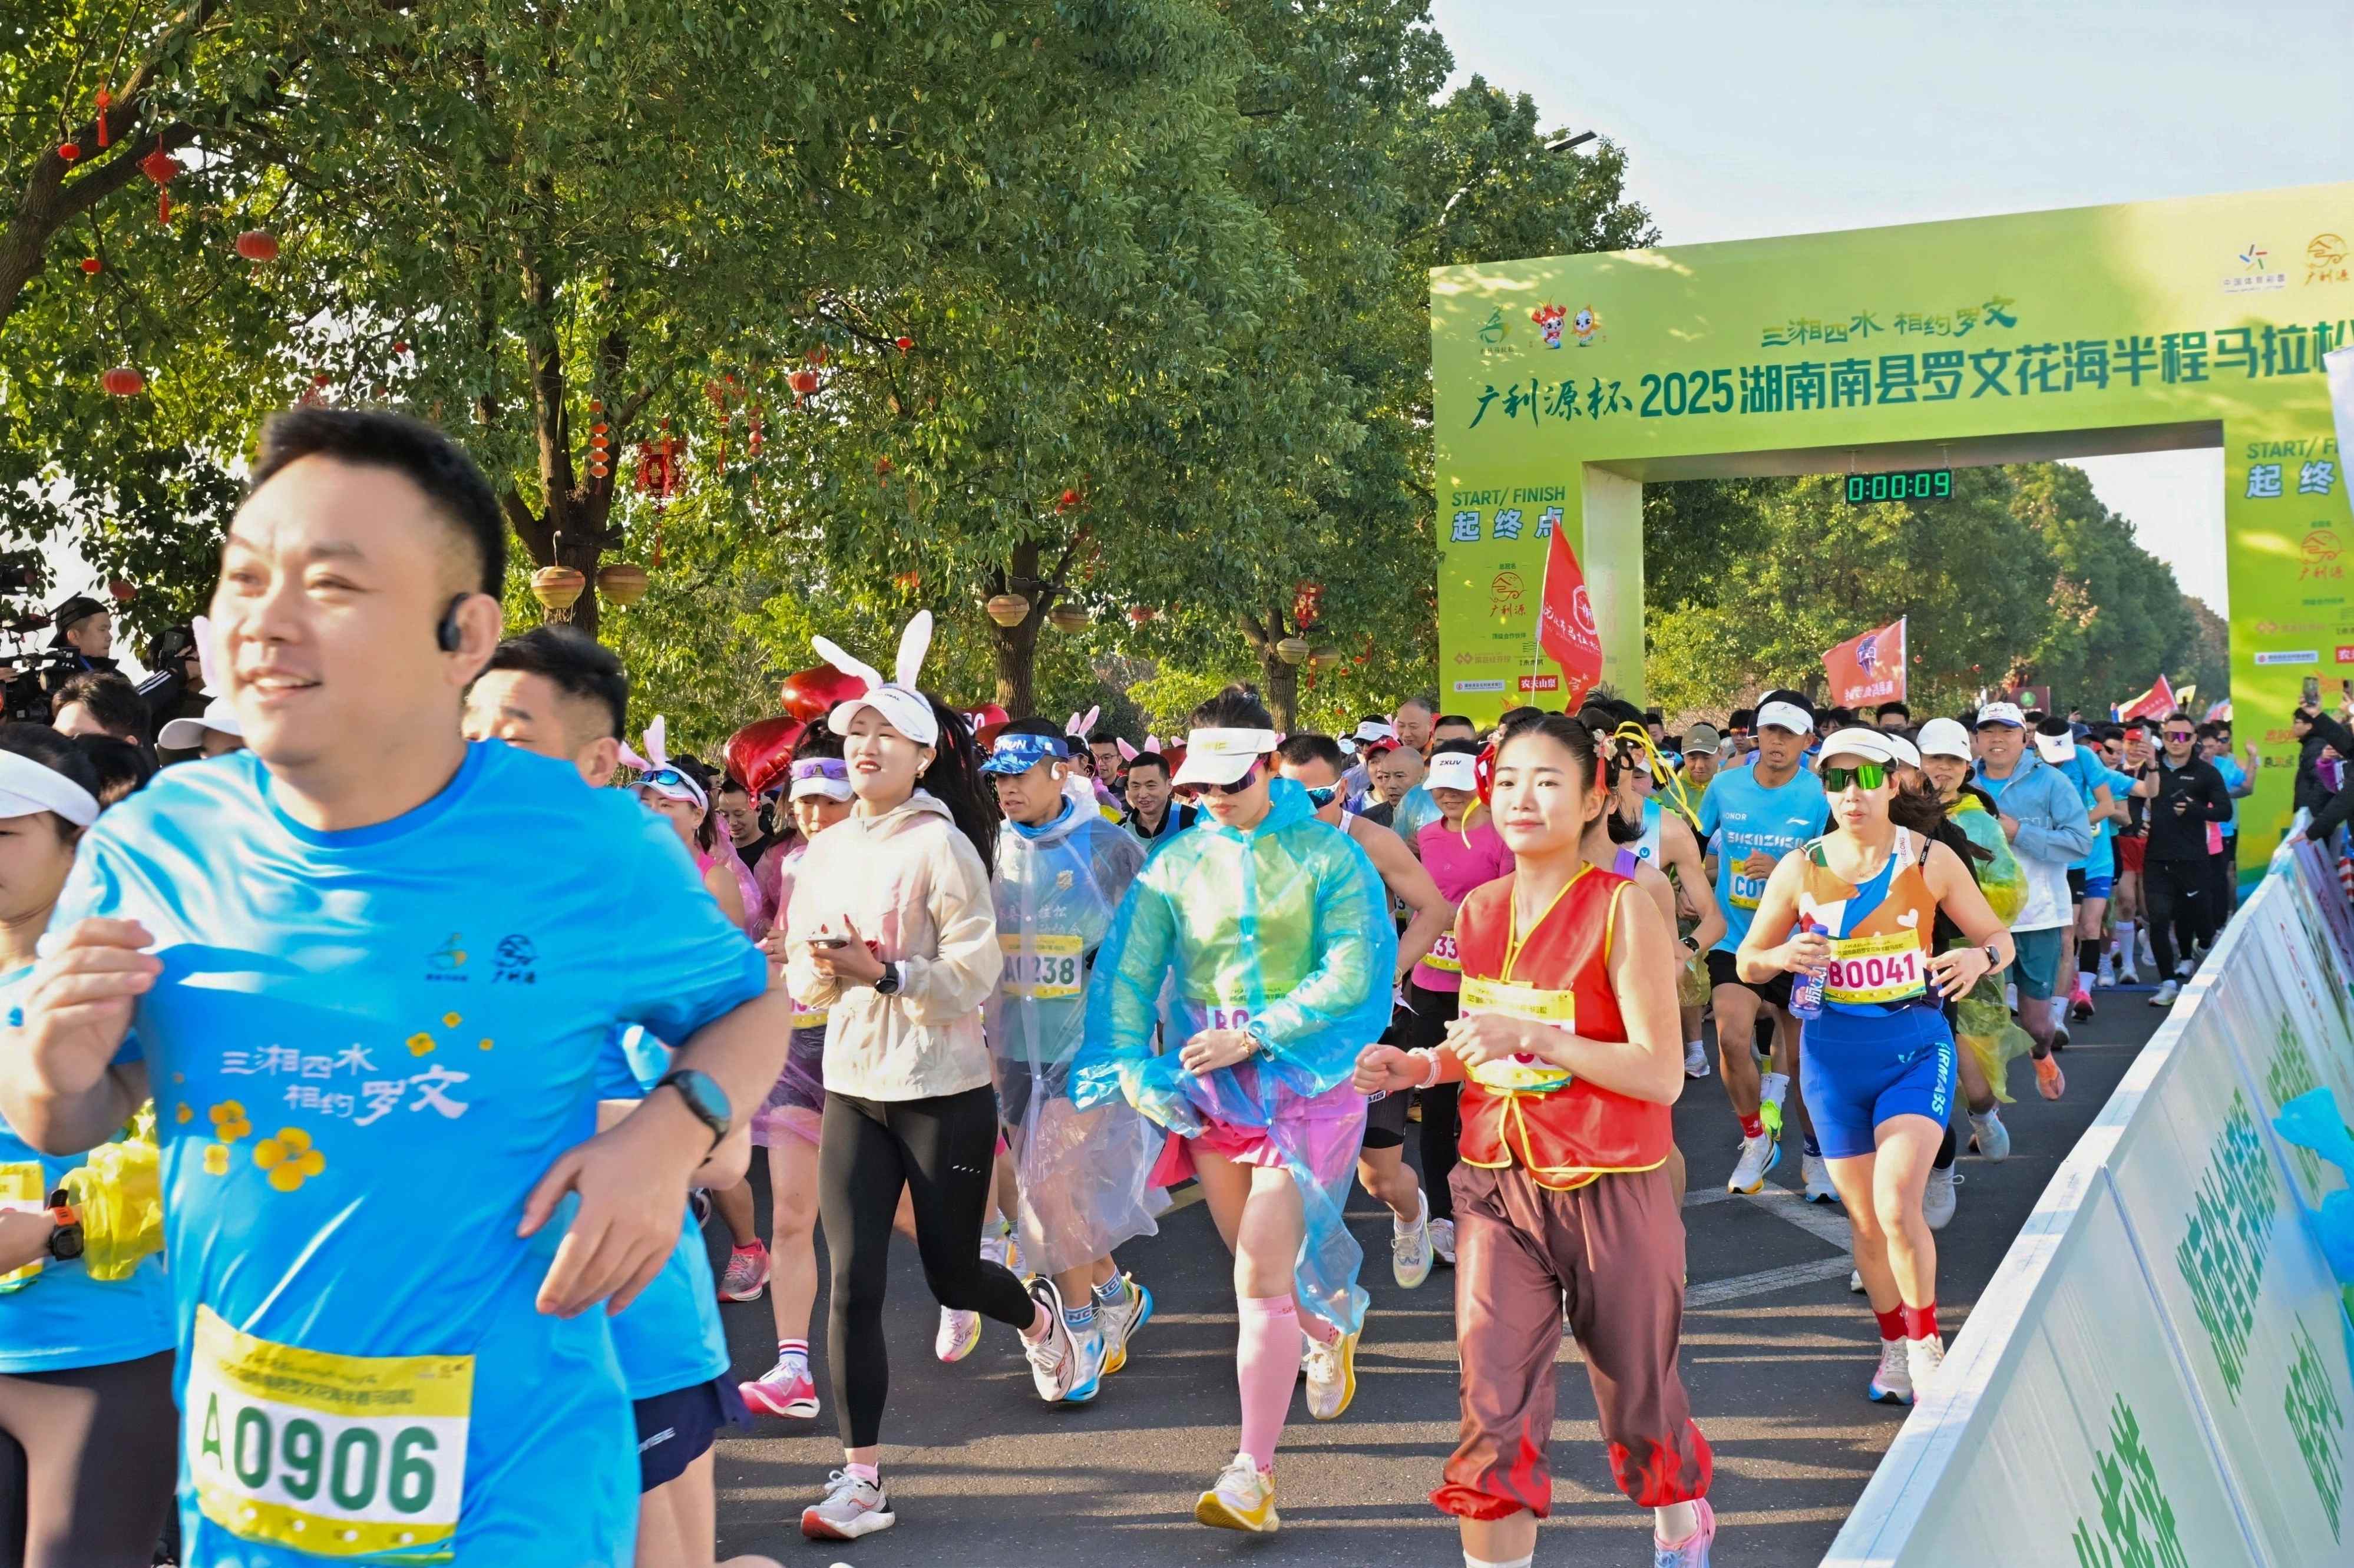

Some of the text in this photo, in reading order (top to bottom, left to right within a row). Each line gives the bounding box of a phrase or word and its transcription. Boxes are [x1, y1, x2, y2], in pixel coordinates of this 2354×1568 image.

[1761, 295, 2018, 348] 三湘四水 相约罗文
[1452, 486, 1566, 507] START/ FINISH
[1848, 472, 1950, 501] 0:00:09
[1449, 506, 1564, 543] 起终点
[1521, 677, 1556, 689] 农夫山泉
[1828, 952, 1916, 989] B0041
[219, 1043, 379, 1079] 三湘四水
[283, 1064, 470, 1127] 相约罗文
[201, 1391, 439, 1514] A0906
